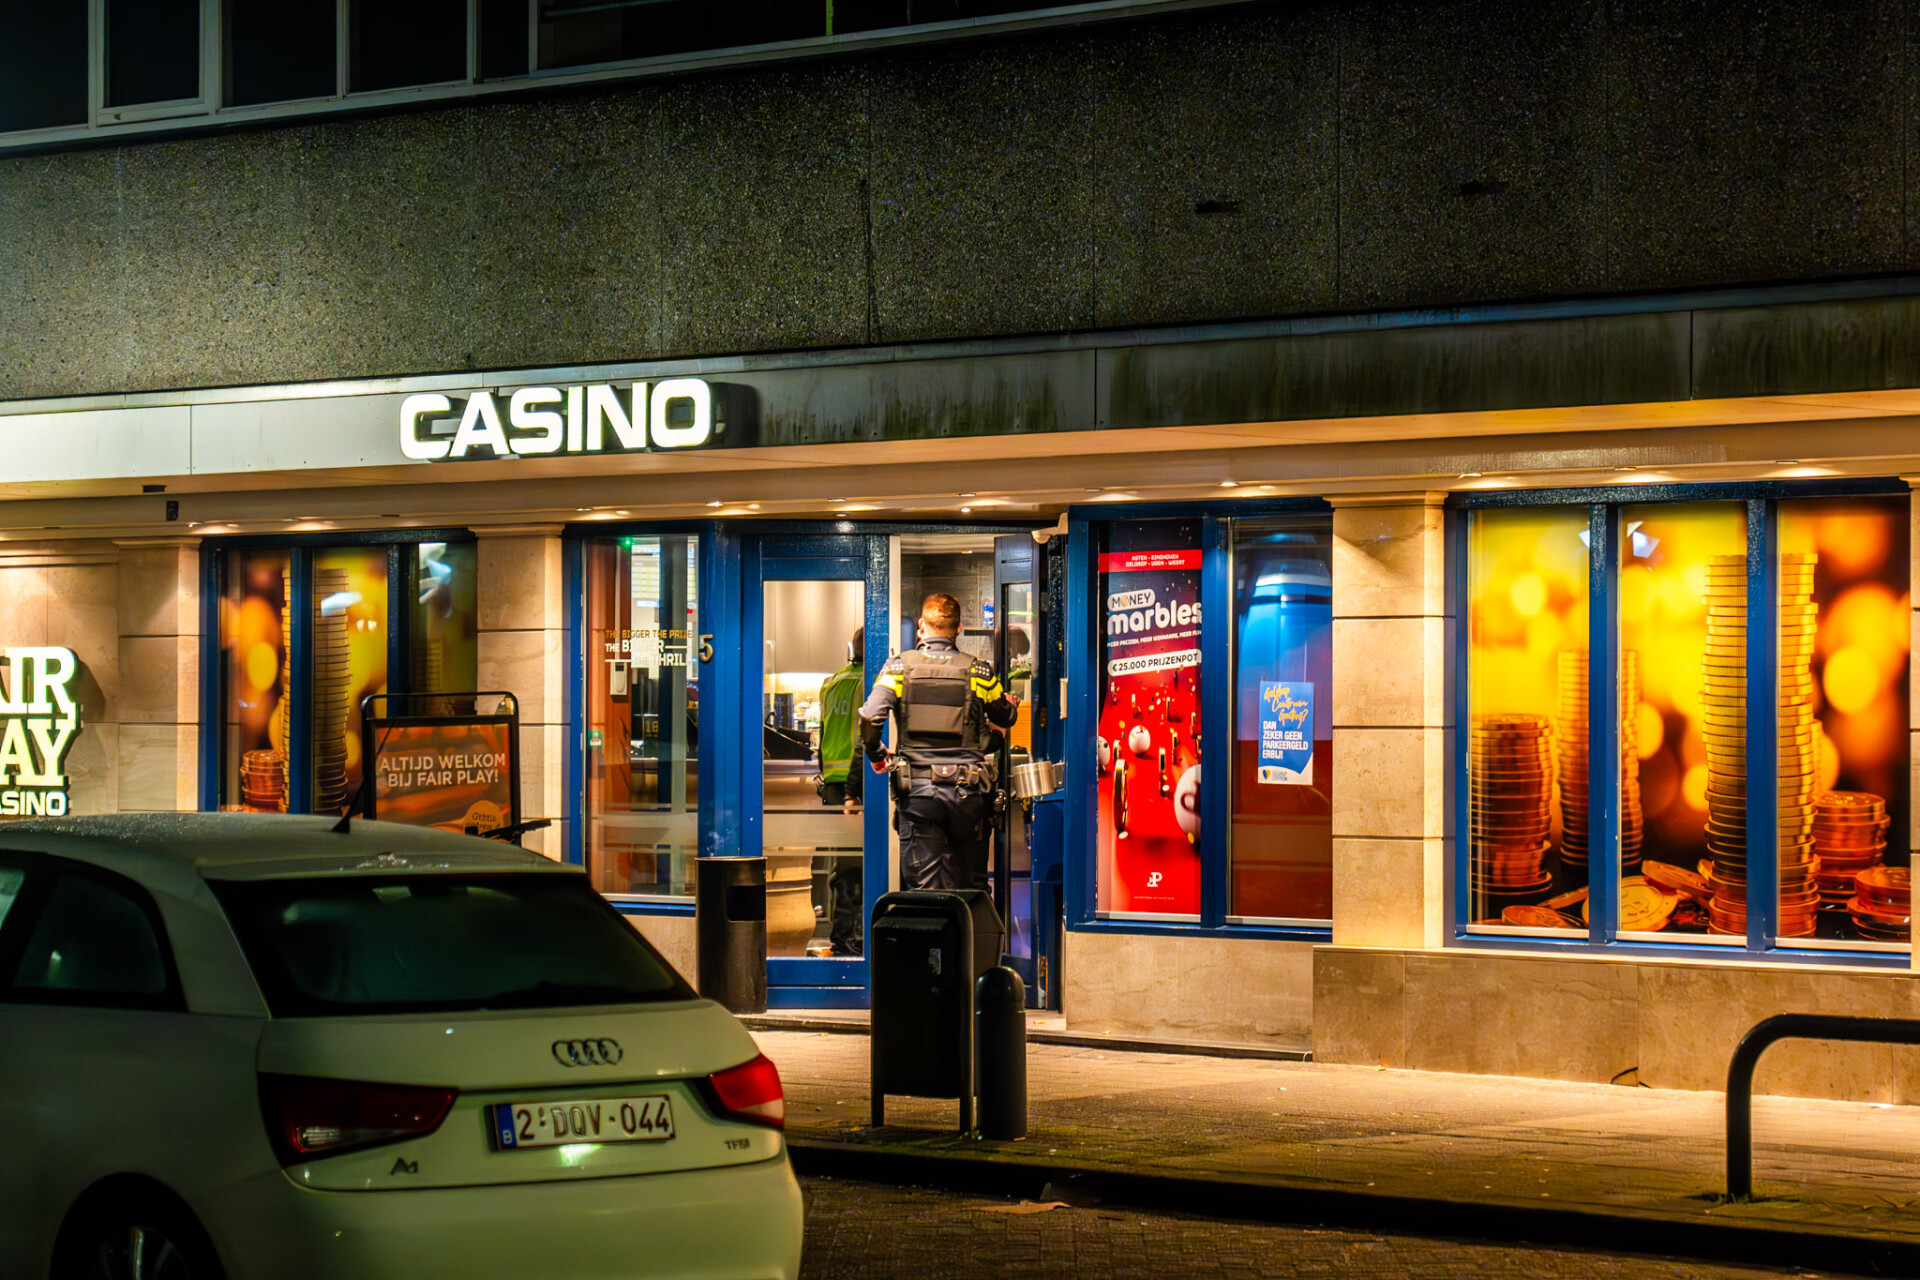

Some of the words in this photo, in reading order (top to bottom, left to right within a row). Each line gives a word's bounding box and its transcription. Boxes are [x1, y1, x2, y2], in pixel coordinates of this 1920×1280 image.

[400, 378, 711, 459] CASINO
[1111, 592, 1151, 609] MONEY
[1107, 599, 1202, 635] marbles
[622, 629, 651, 639] BIGGER
[653, 629, 668, 639] THE
[669, 629, 693, 639] PRIZE
[605, 643, 620, 653] THE
[651, 653, 688, 667] THRIL
[1148, 652, 1198, 667] PRIJZENPOT
[0, 646, 77, 720] IR
[1262, 720, 1277, 730] DAN
[1262, 730, 1283, 740] ZEKER
[1284, 731, 1303, 741] GEEN
[1262, 740, 1309, 751] PARKEERGELD
[379, 755, 434, 772] ALTIJD
[438, 752, 506, 770] WELKOM
[388, 772, 412, 788] BIJ
[417, 771, 452, 786] FAIR
[457, 769, 499, 785] PLAY!
[0, 790, 67, 816] SINO
